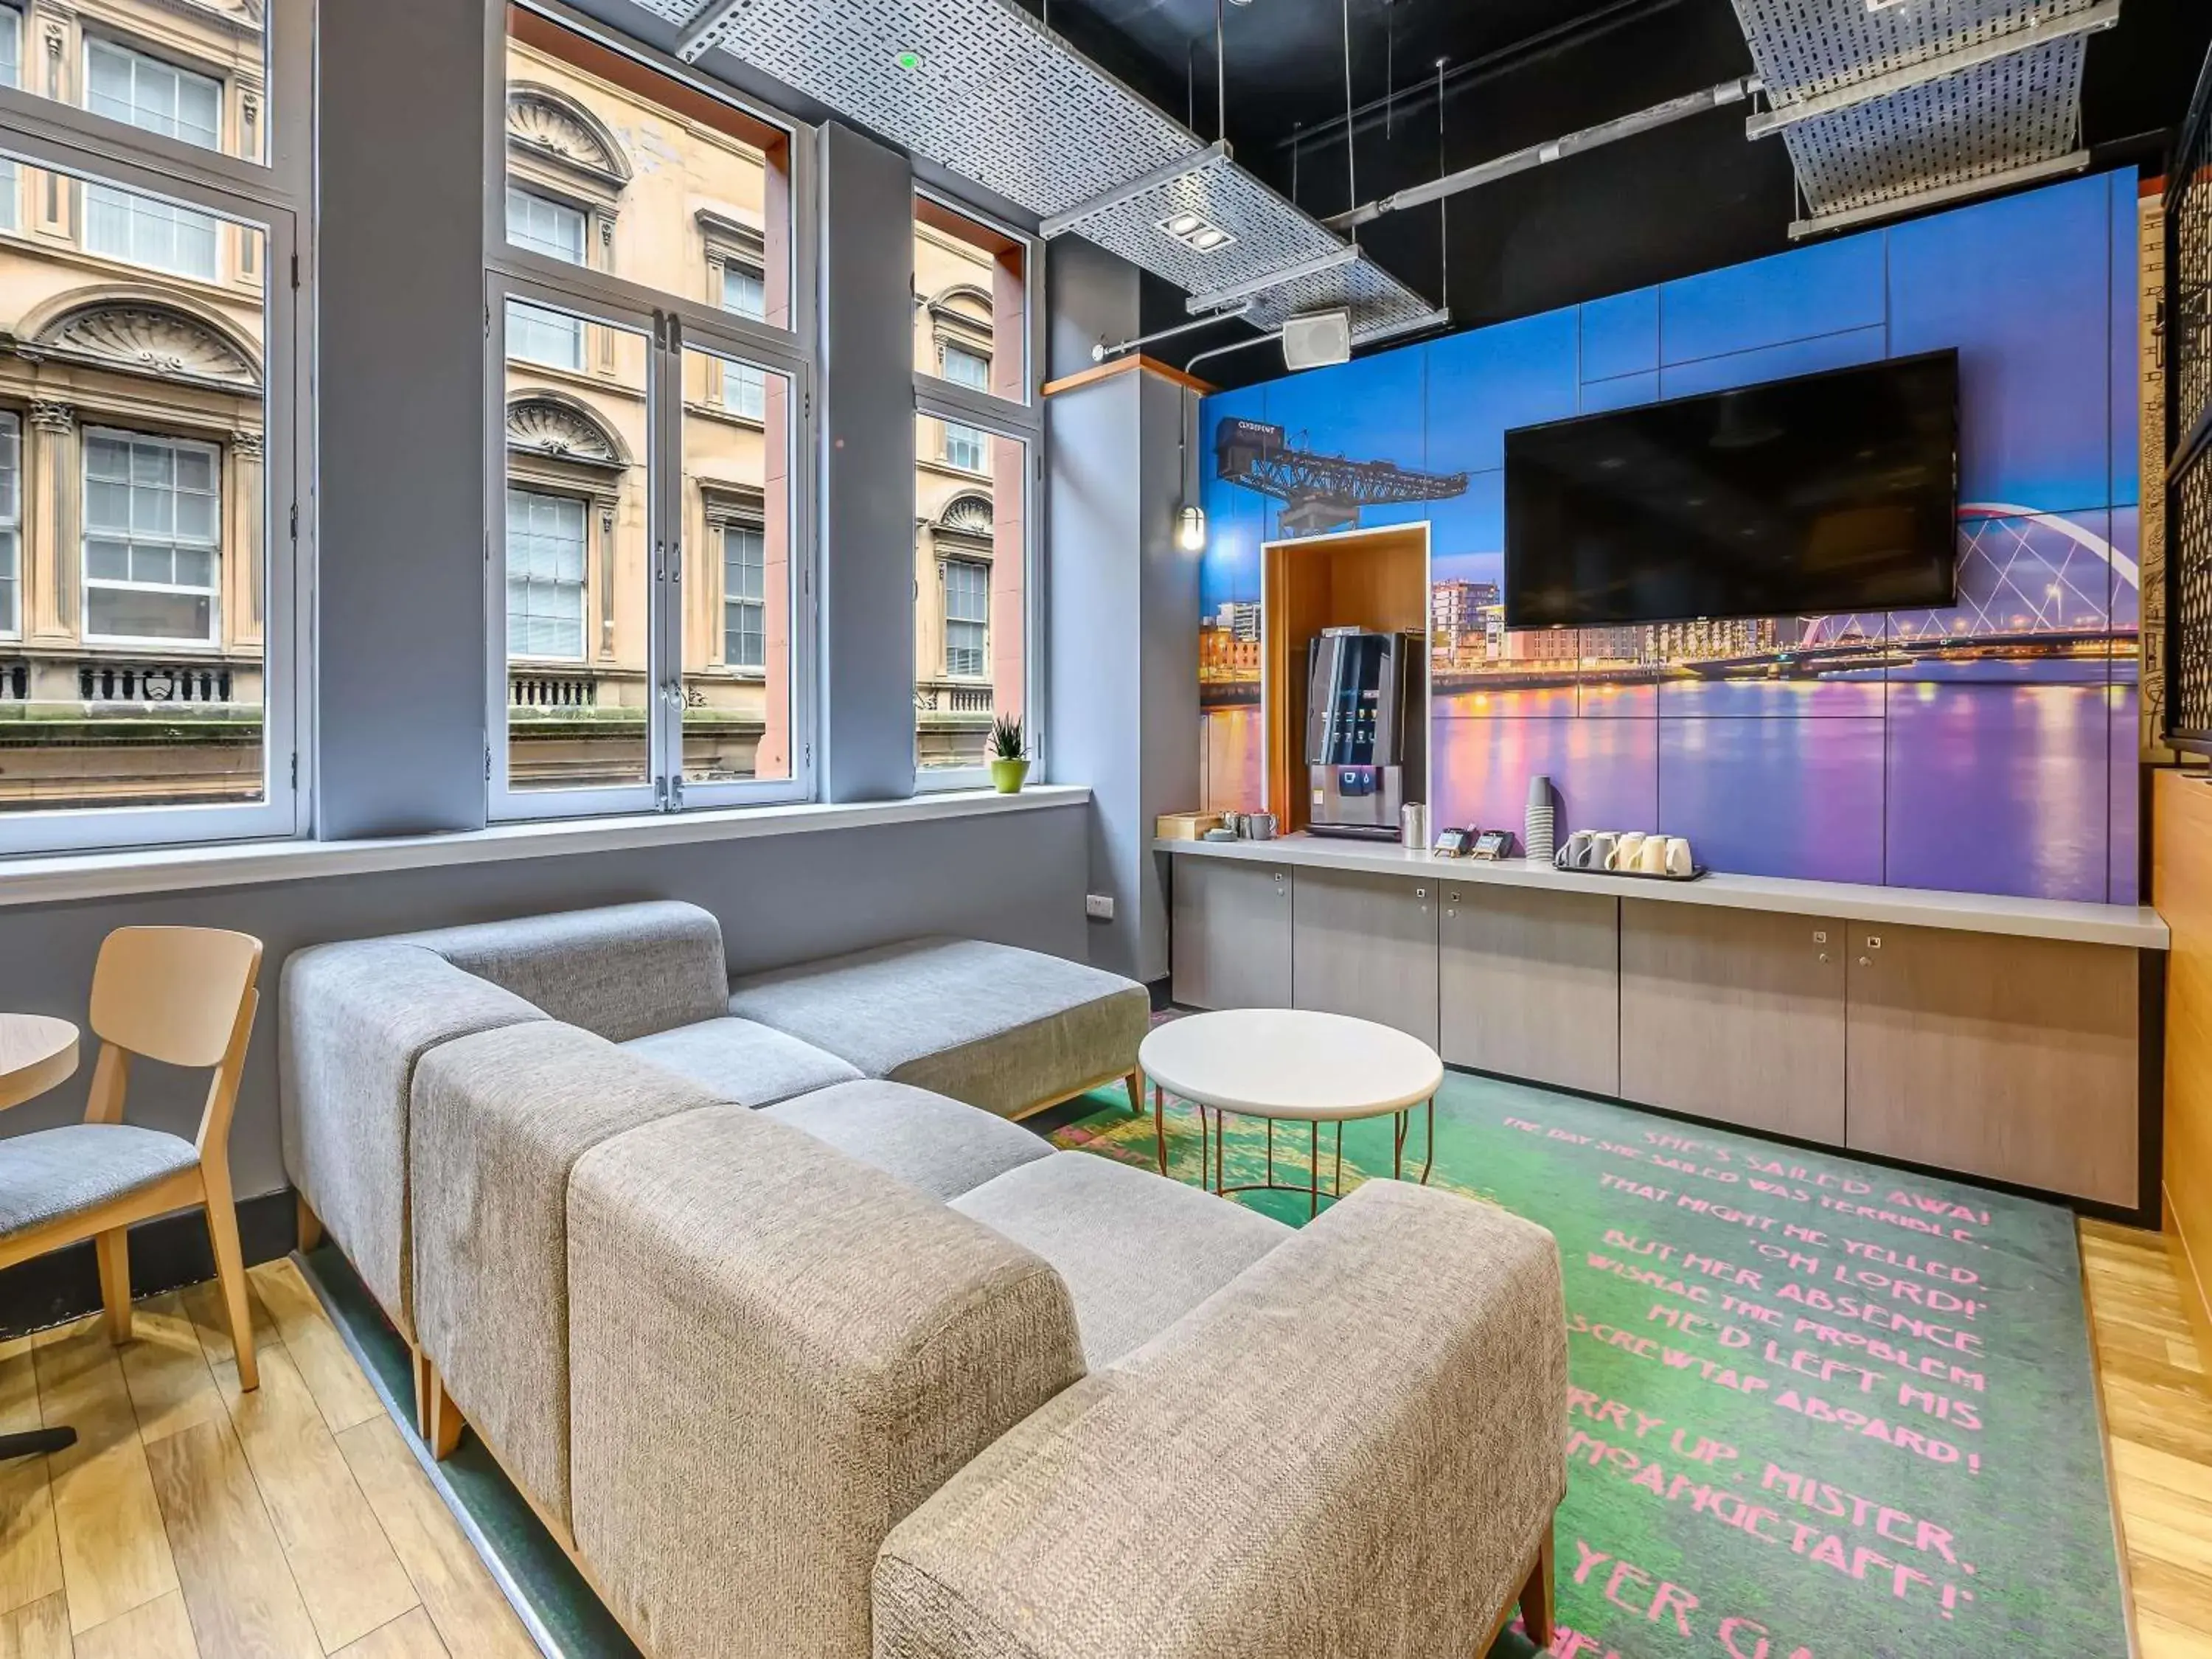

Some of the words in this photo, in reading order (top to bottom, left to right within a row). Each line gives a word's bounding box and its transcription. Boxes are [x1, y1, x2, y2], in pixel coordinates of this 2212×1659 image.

[1503, 1117, 1542, 1133] THE
[1546, 1128, 1593, 1144] DAY
[1595, 1141, 1644, 1158] SHE
[1649, 1155, 1739, 1183] SAILED
[1748, 1178, 1810, 1201] WAS
[1745, 1155, 1871, 1194] SAILED
[1886, 1190, 1990, 1225] AWA!
[1601, 1172, 1672, 1202] THAT
[1783, 1224, 1829, 1248] HE
[1601, 1229, 1677, 1261] BUT
[1683, 1253, 1763, 1290] HER
[1775, 1283, 1984, 1357] ABSENCE
[1721, 1293, 1784, 1326] THE
[1794, 1318, 1985, 1391] PROBLEM
[1764, 1339, 1886, 1393] LEFT
[1899, 1382, 1982, 1429] HIS
[1566, 1386, 1666, 1437] RRY
[1775, 1390, 1980, 1475] ABOARD!
[1573, 1537, 1700, 1637] YER
